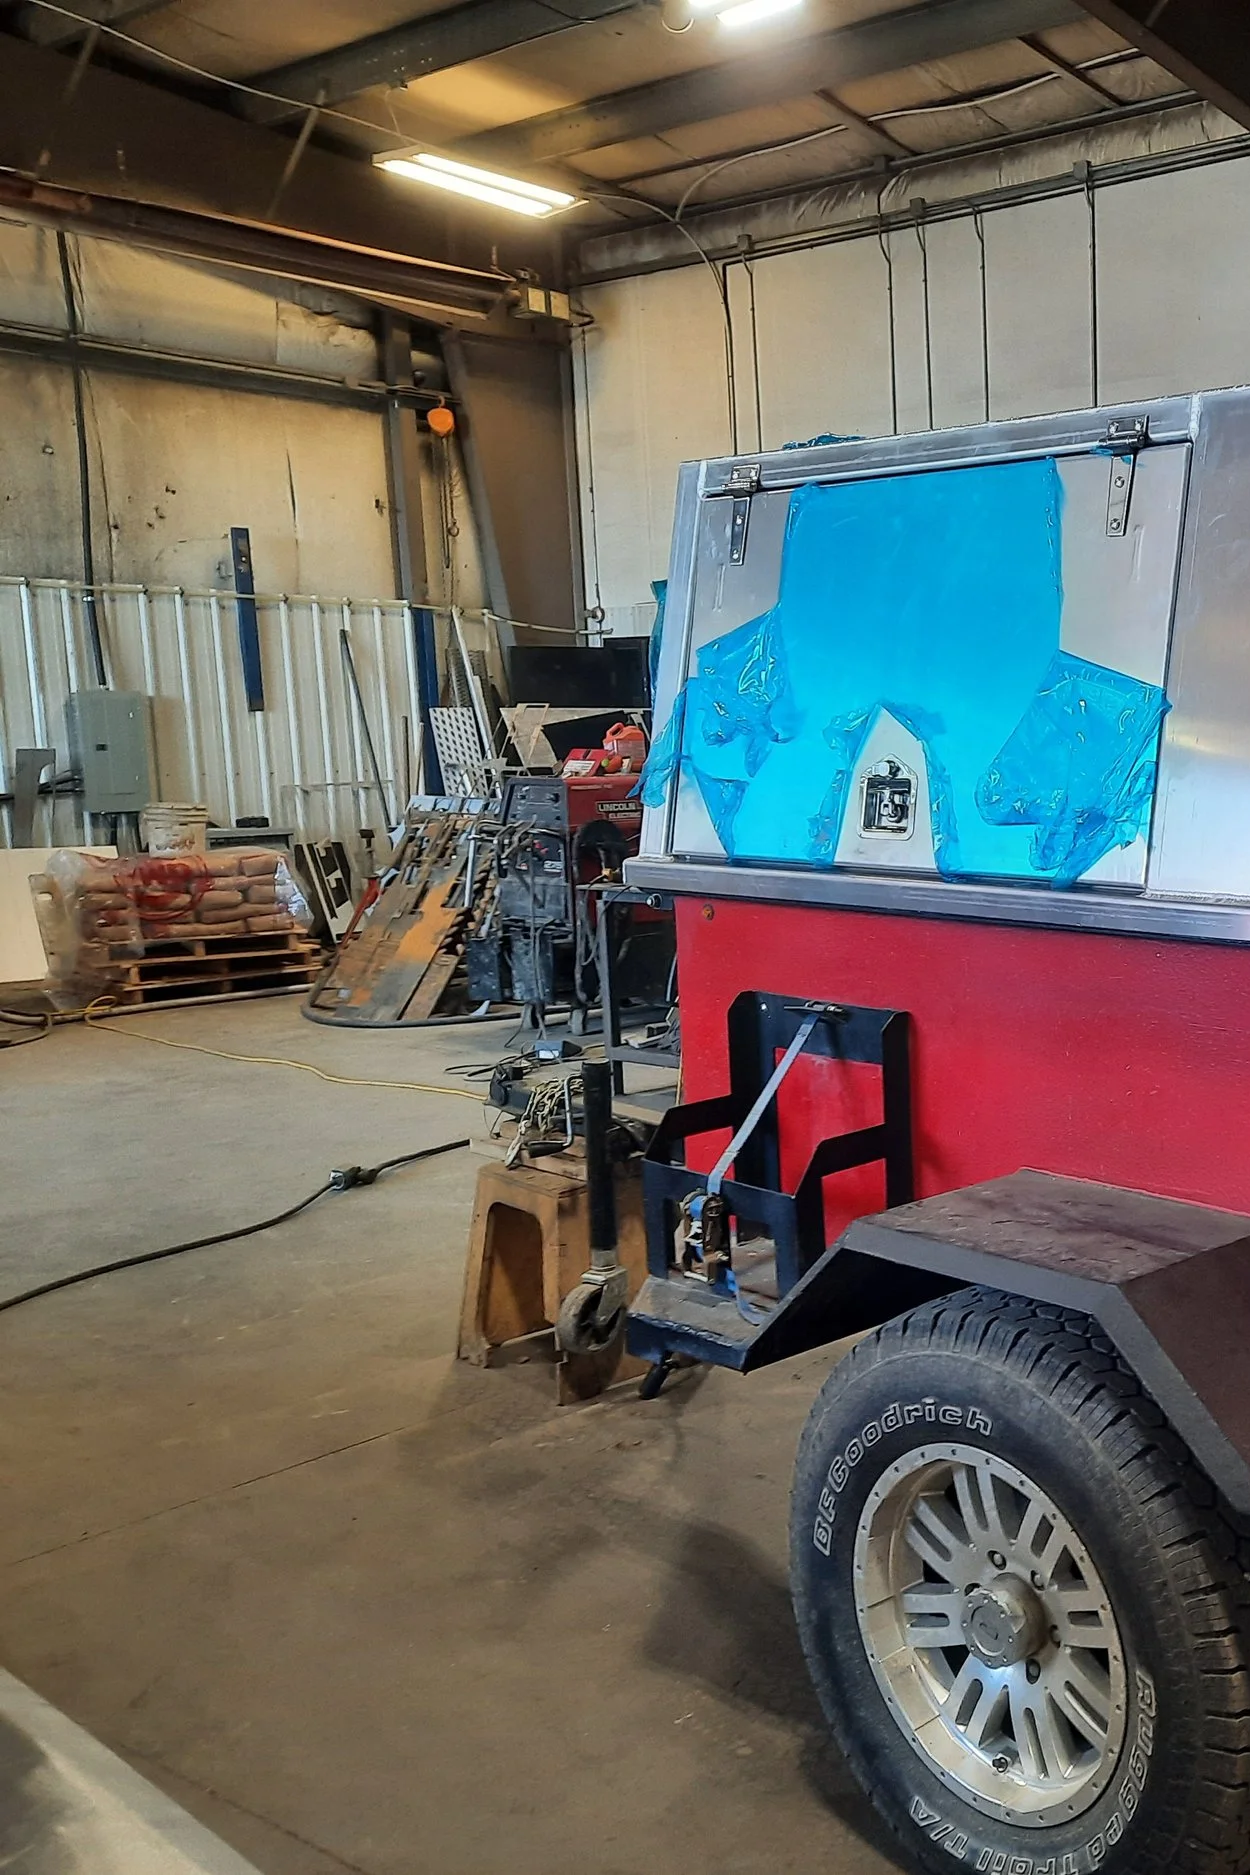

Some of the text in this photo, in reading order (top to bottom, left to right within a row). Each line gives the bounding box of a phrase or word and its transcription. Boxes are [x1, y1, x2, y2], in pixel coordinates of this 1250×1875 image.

[598, 803, 636, 812] LINCOLN
[813, 1397, 994, 1557] BFGoodrich
[1085, 1669, 1157, 1871] Rugged
[908, 1796, 970, 1861] T/A
